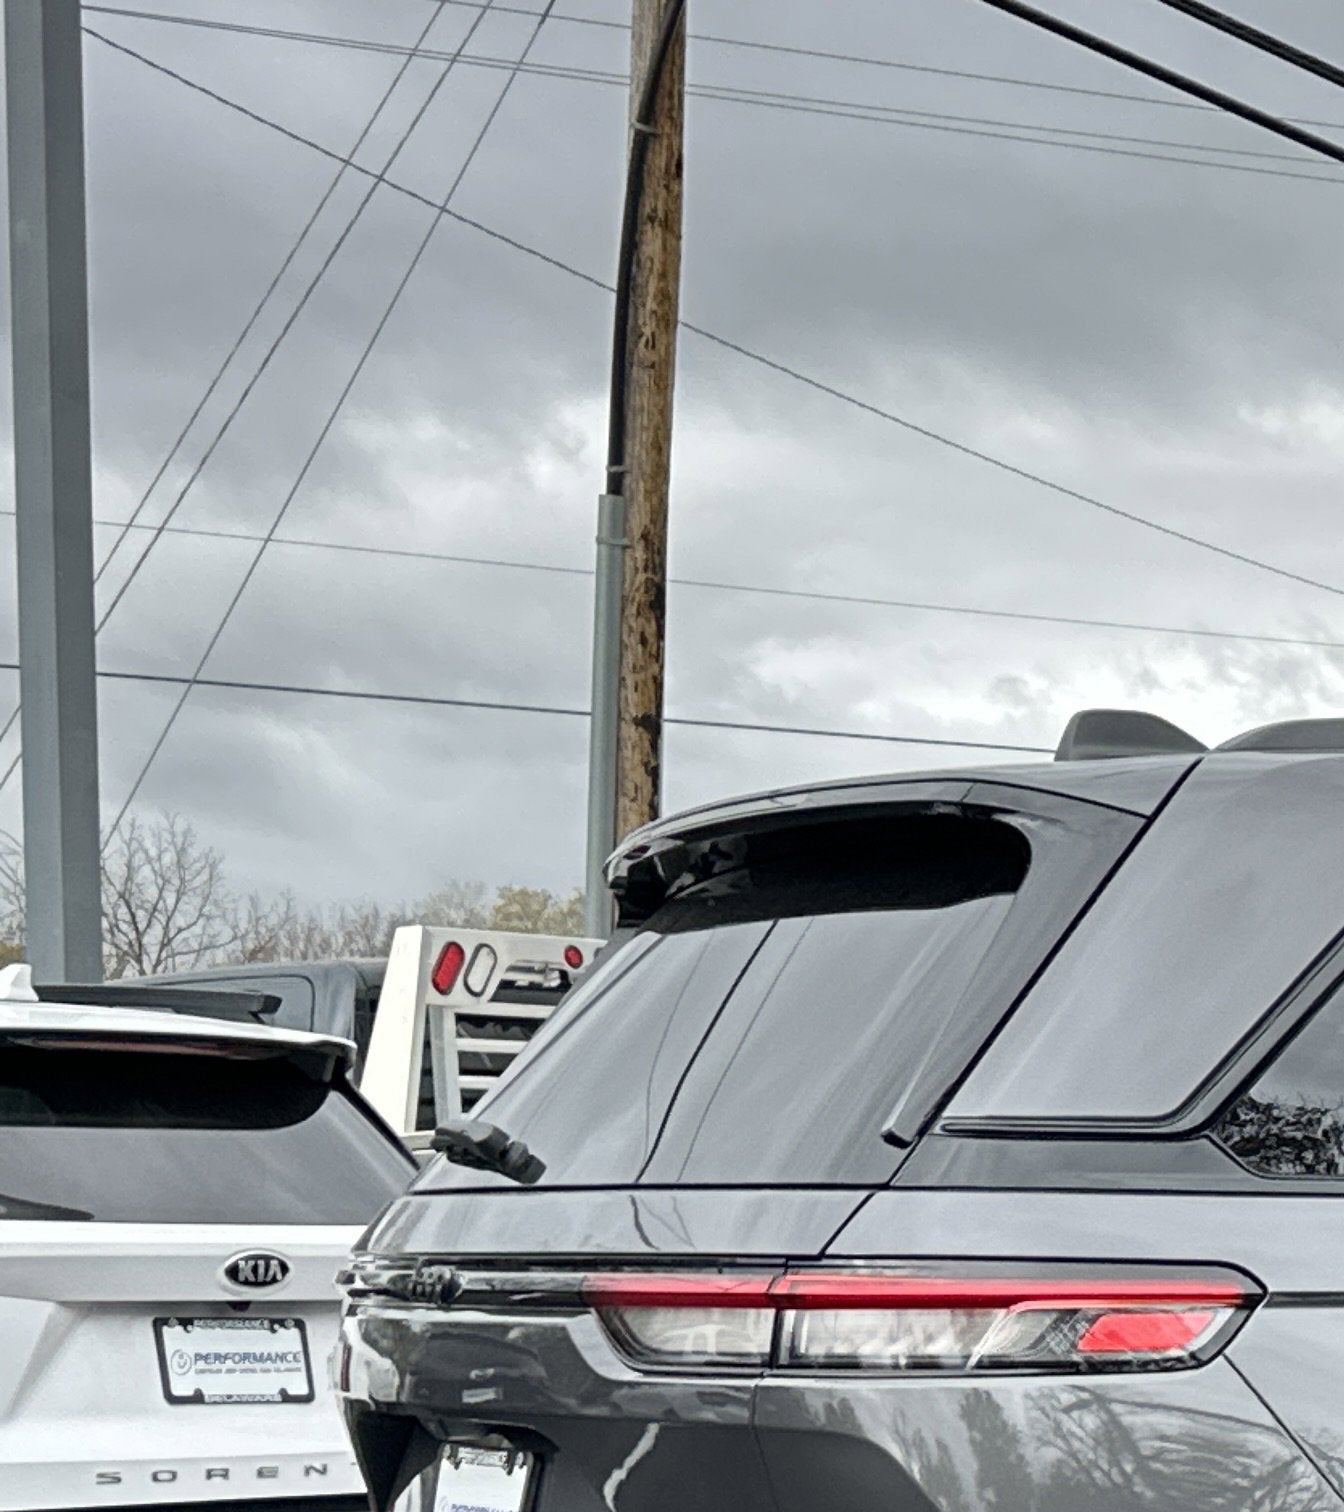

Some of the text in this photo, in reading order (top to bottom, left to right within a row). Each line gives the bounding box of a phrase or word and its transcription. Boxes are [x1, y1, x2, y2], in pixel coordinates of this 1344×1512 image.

[237, 1259, 283, 1282] KIA
[193, 1351, 303, 1366] PERFORMANCE
[96, 1463, 357, 1486] SOREN
